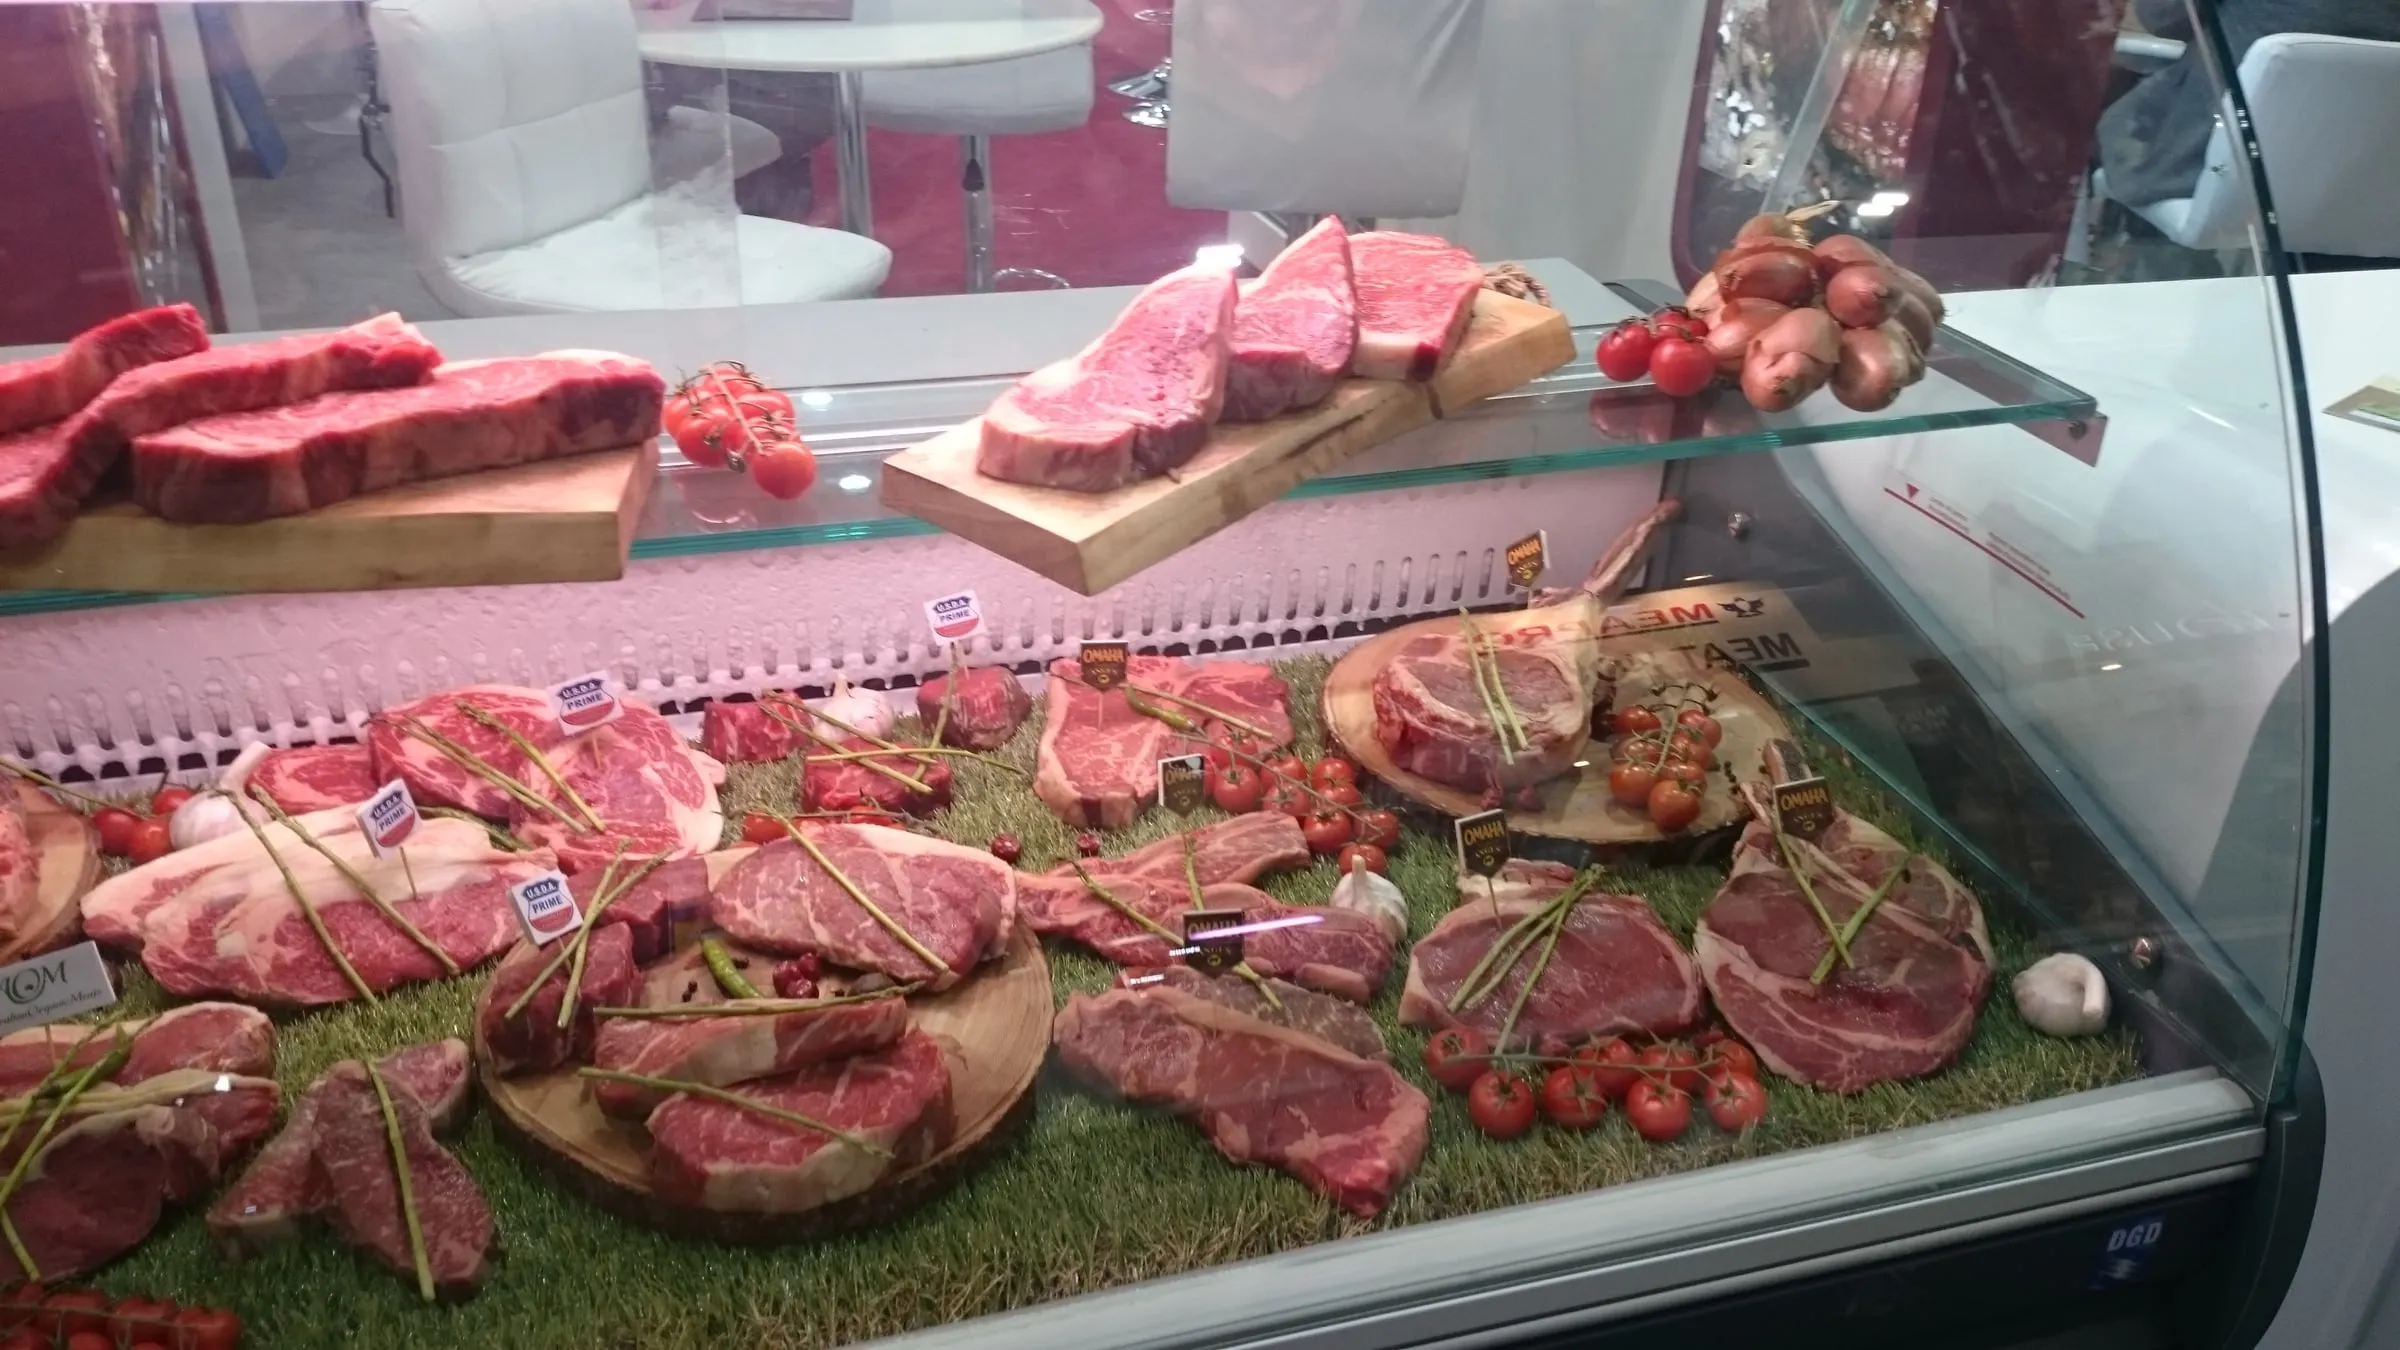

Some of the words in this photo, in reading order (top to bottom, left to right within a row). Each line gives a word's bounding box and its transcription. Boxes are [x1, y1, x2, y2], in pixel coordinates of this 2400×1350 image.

[939, 609, 971, 623] PRIME
[1083, 648, 1125, 663] OMAHA
[566, 693, 604, 711] PRIME
[1781, 787, 1829, 811] OMAHA
[379, 806, 406, 832] PRIME
[1464, 820, 1506, 847] OMAHA
[532, 895, 563, 915] PRIME
[2107, 1222, 2162, 1252] DGD
